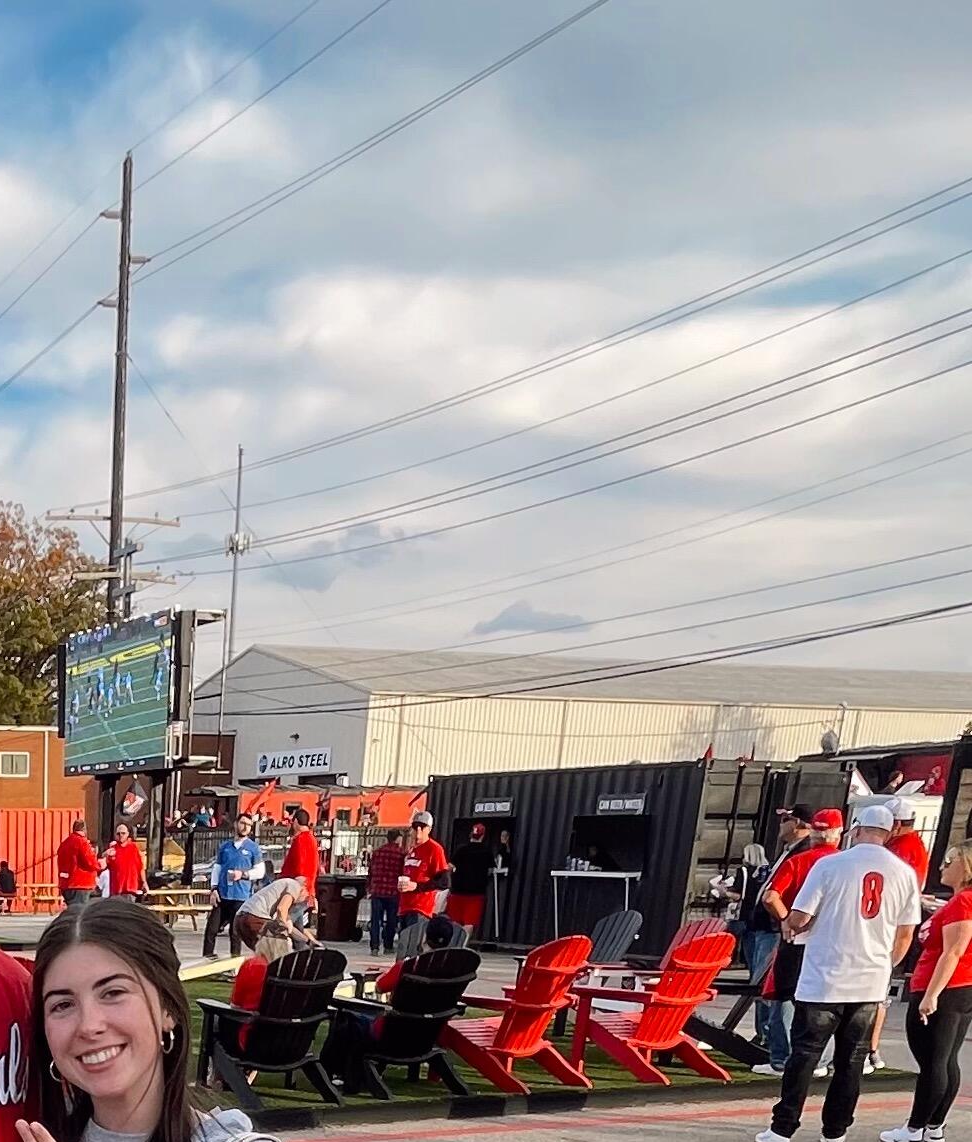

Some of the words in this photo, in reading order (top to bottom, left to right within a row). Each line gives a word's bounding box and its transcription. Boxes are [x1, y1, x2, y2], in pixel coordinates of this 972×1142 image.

[270, 755, 295, 769] ALRO
[298, 753, 328, 768] STEEL
[861, 871, 884, 919] 8
